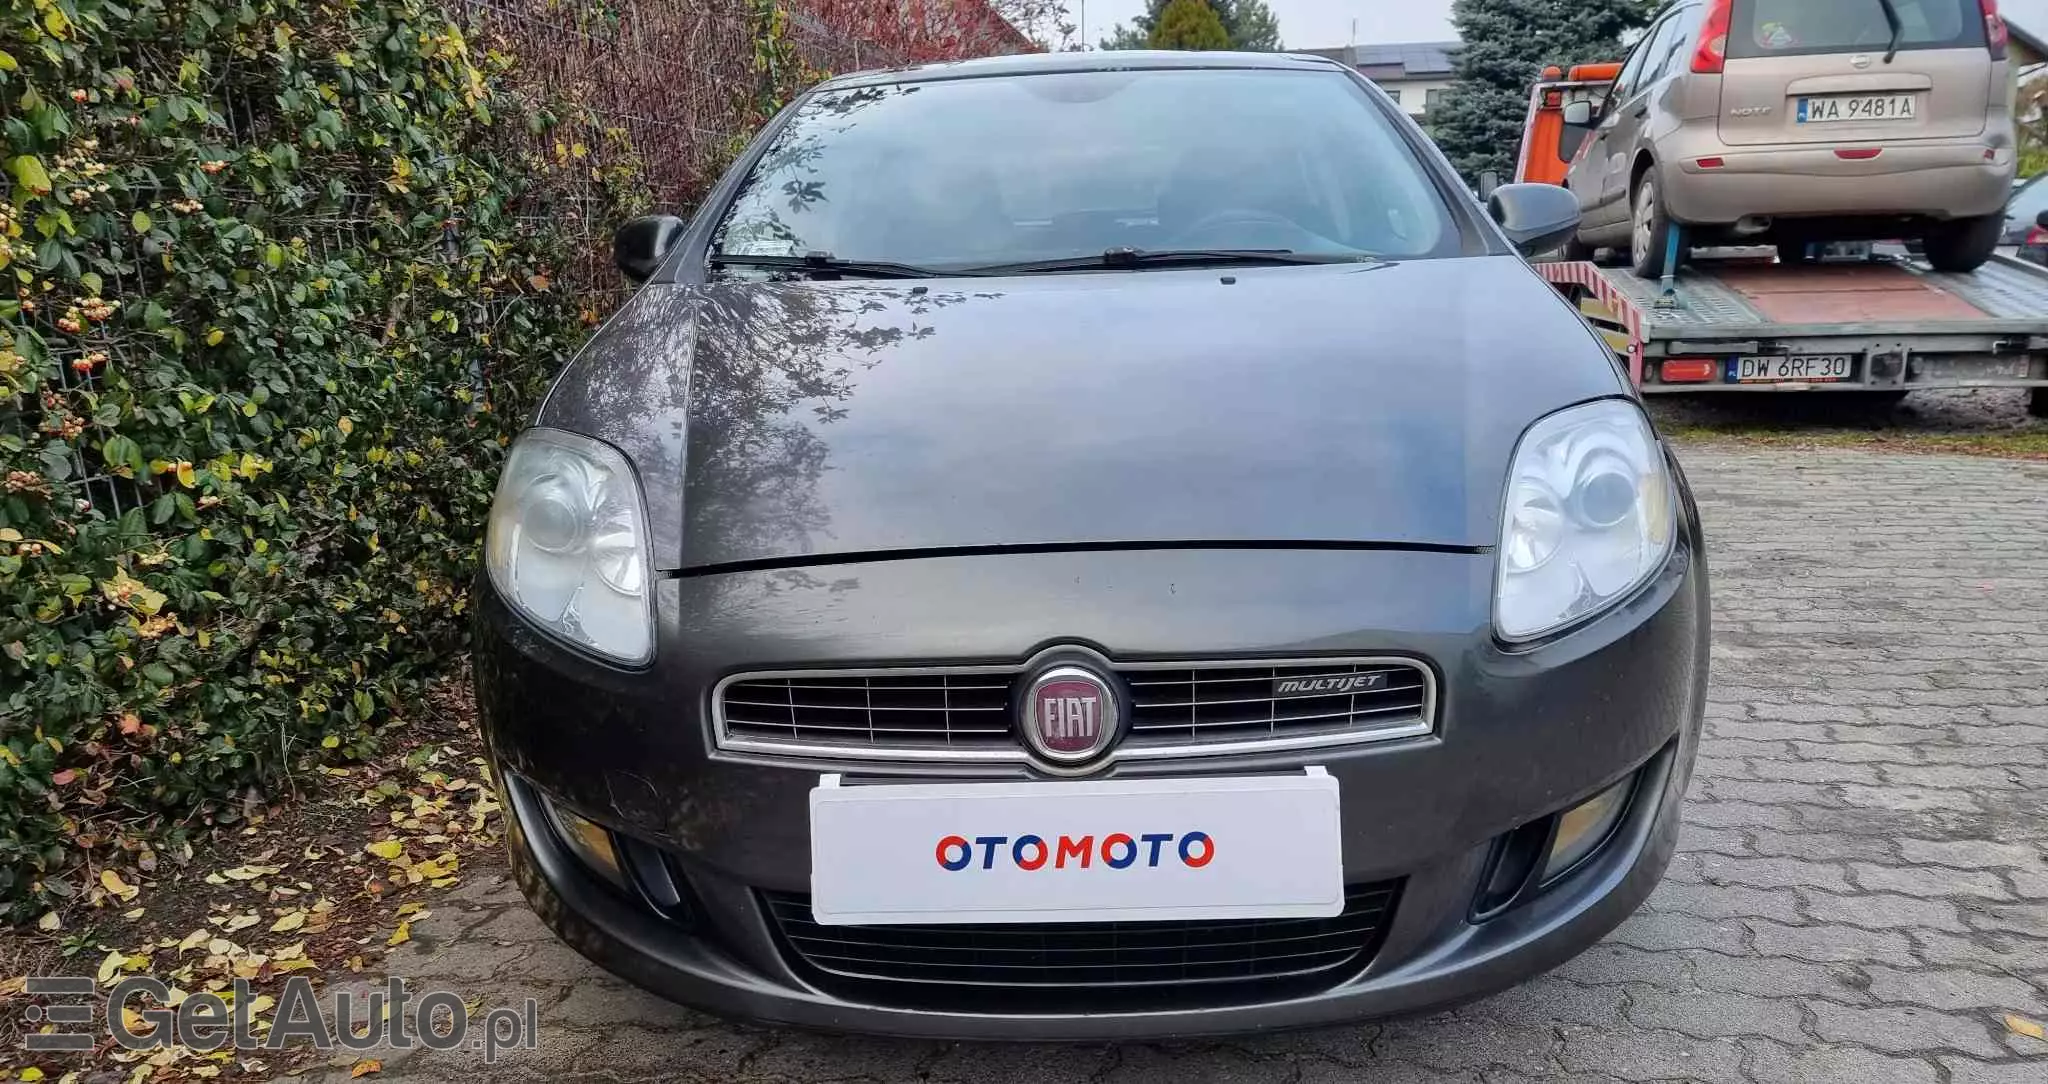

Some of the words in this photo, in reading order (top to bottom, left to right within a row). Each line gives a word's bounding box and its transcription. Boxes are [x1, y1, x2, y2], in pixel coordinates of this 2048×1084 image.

[1811, 99, 1839, 119] WA
[1848, 97, 1912, 118] 9481A
[1742, 359, 1769, 377] DW
[1778, 356, 1845, 377] 6RF30
[1278, 674, 1381, 692] MULTIJET
[1044, 697, 1097, 737] FIAT
[935, 831, 1214, 871] OTOMOTO
